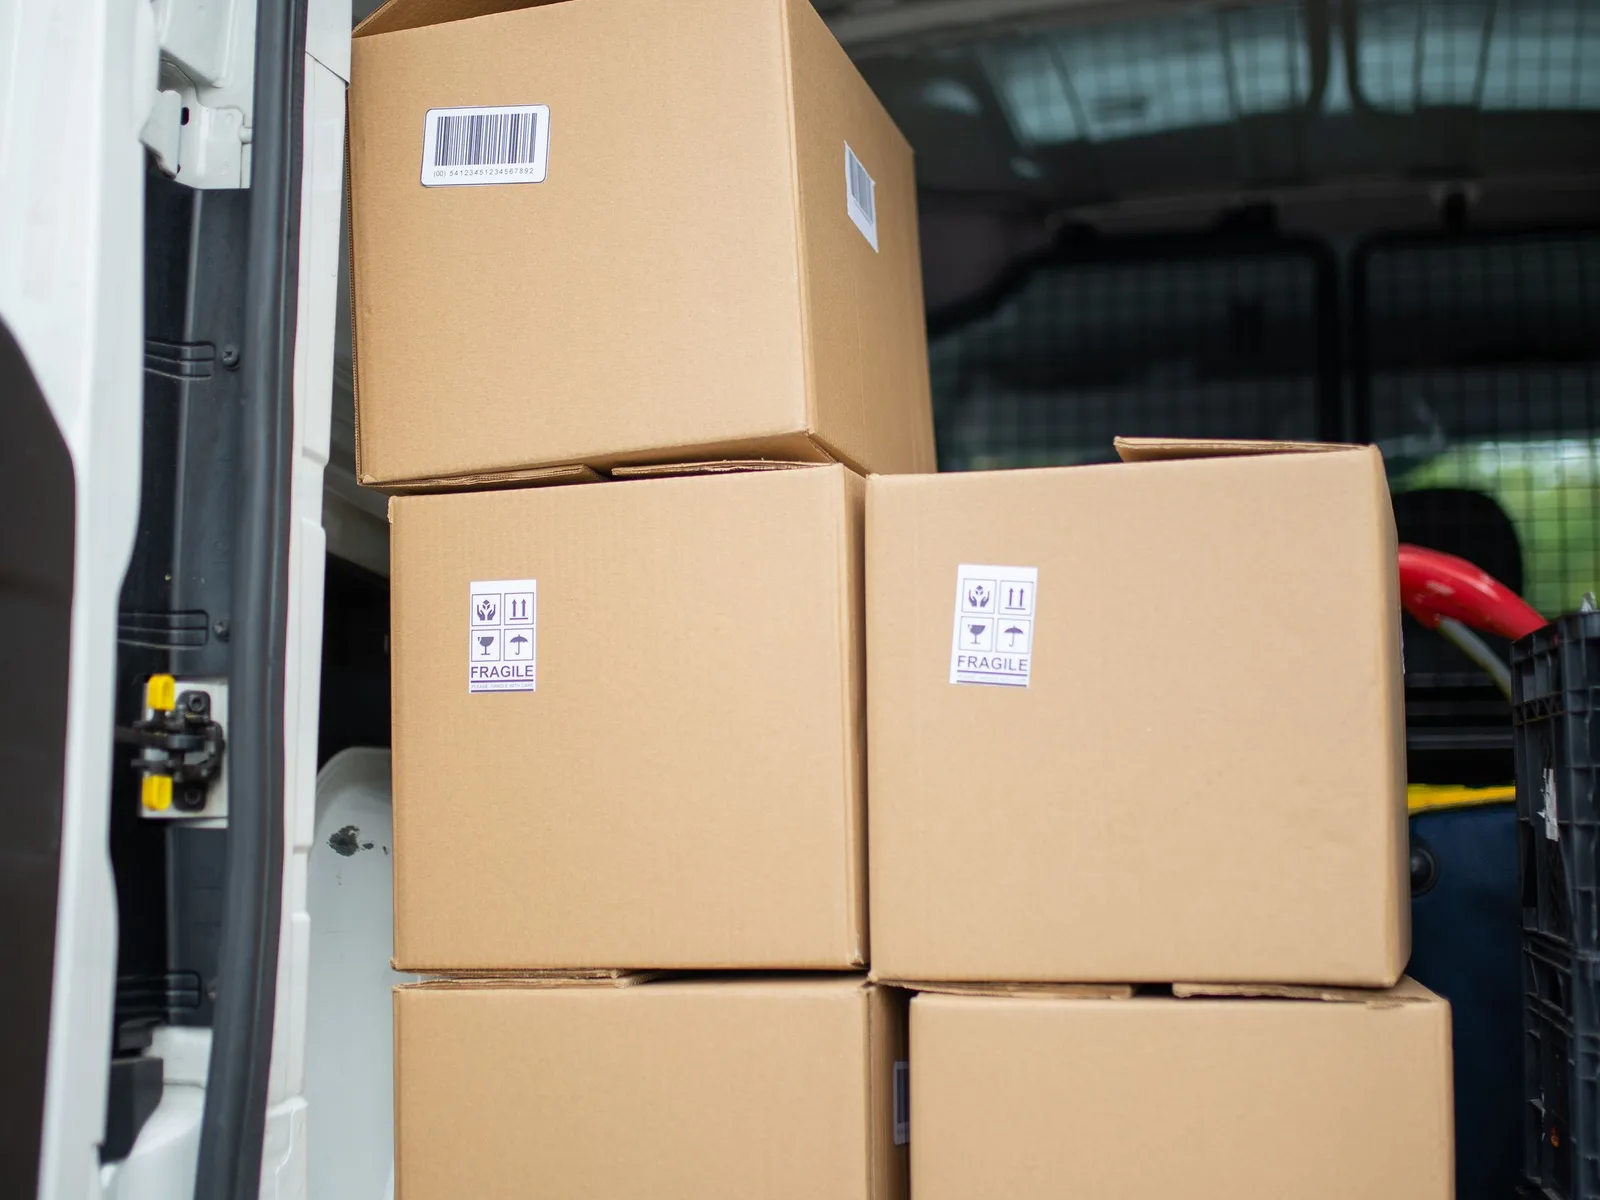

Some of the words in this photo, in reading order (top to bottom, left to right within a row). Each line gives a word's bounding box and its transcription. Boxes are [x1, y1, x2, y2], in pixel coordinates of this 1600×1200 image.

[433, 170, 446, 178] (00)
[449, 167, 534, 177] 54123451234567892
[957, 655, 1028, 672] FRAGILE
[471, 665, 534, 678] FRAGILE
